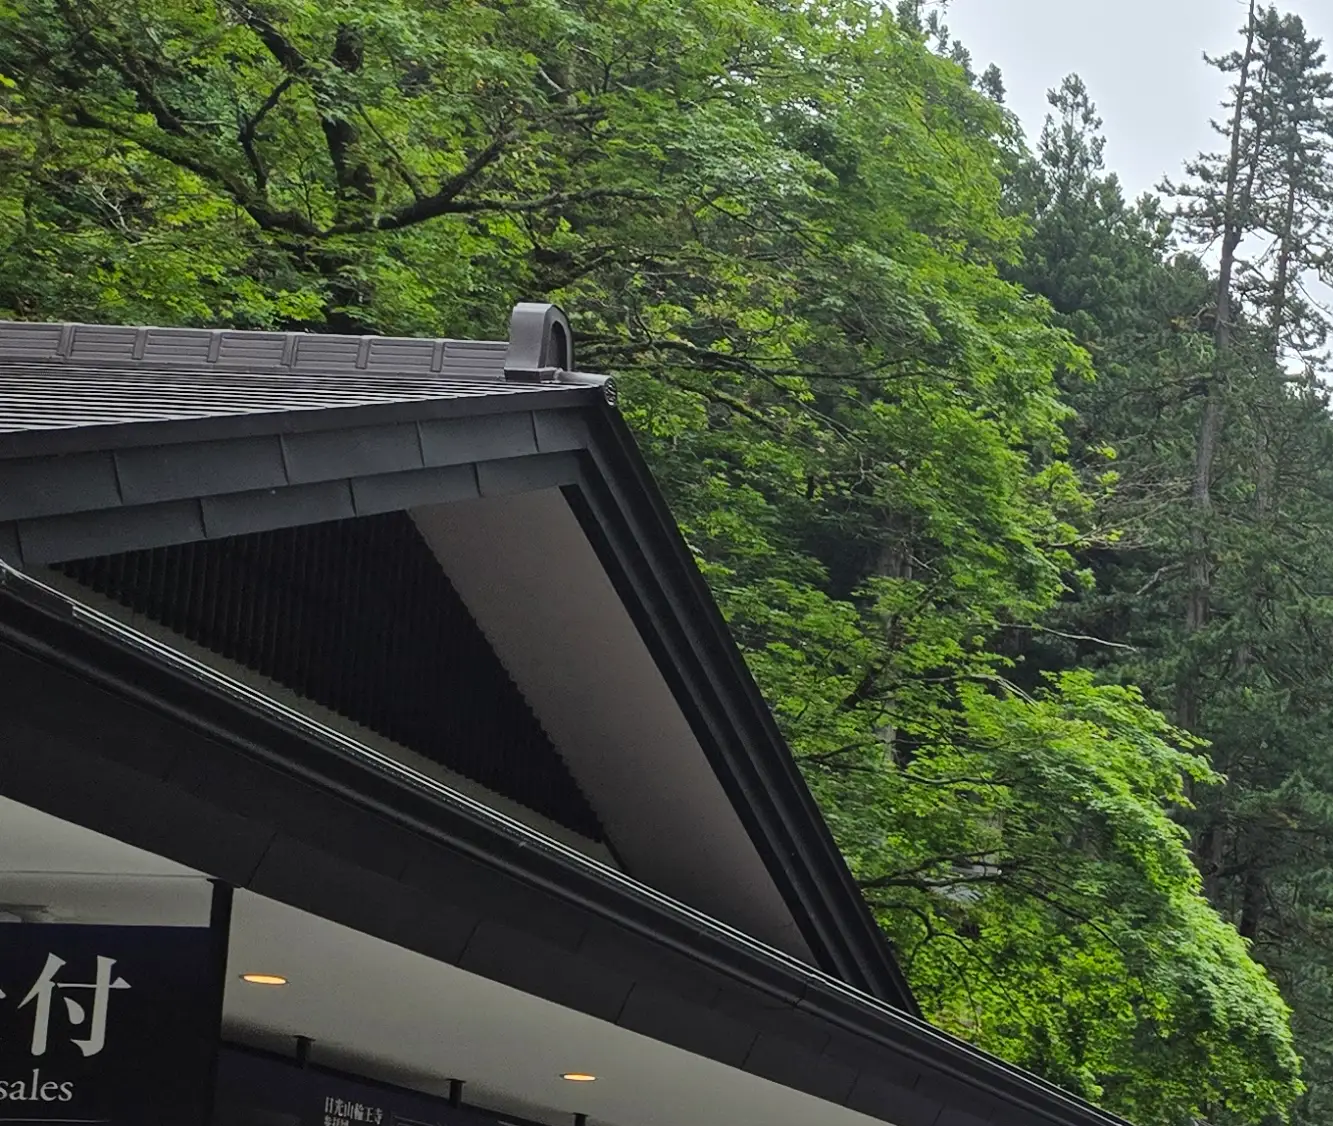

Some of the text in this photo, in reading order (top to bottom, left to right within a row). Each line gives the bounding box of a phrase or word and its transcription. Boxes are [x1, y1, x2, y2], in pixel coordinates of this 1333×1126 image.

[0, 1068, 74, 1101] sales
[325, 1096, 383, 1125] 日光山輪王寺
